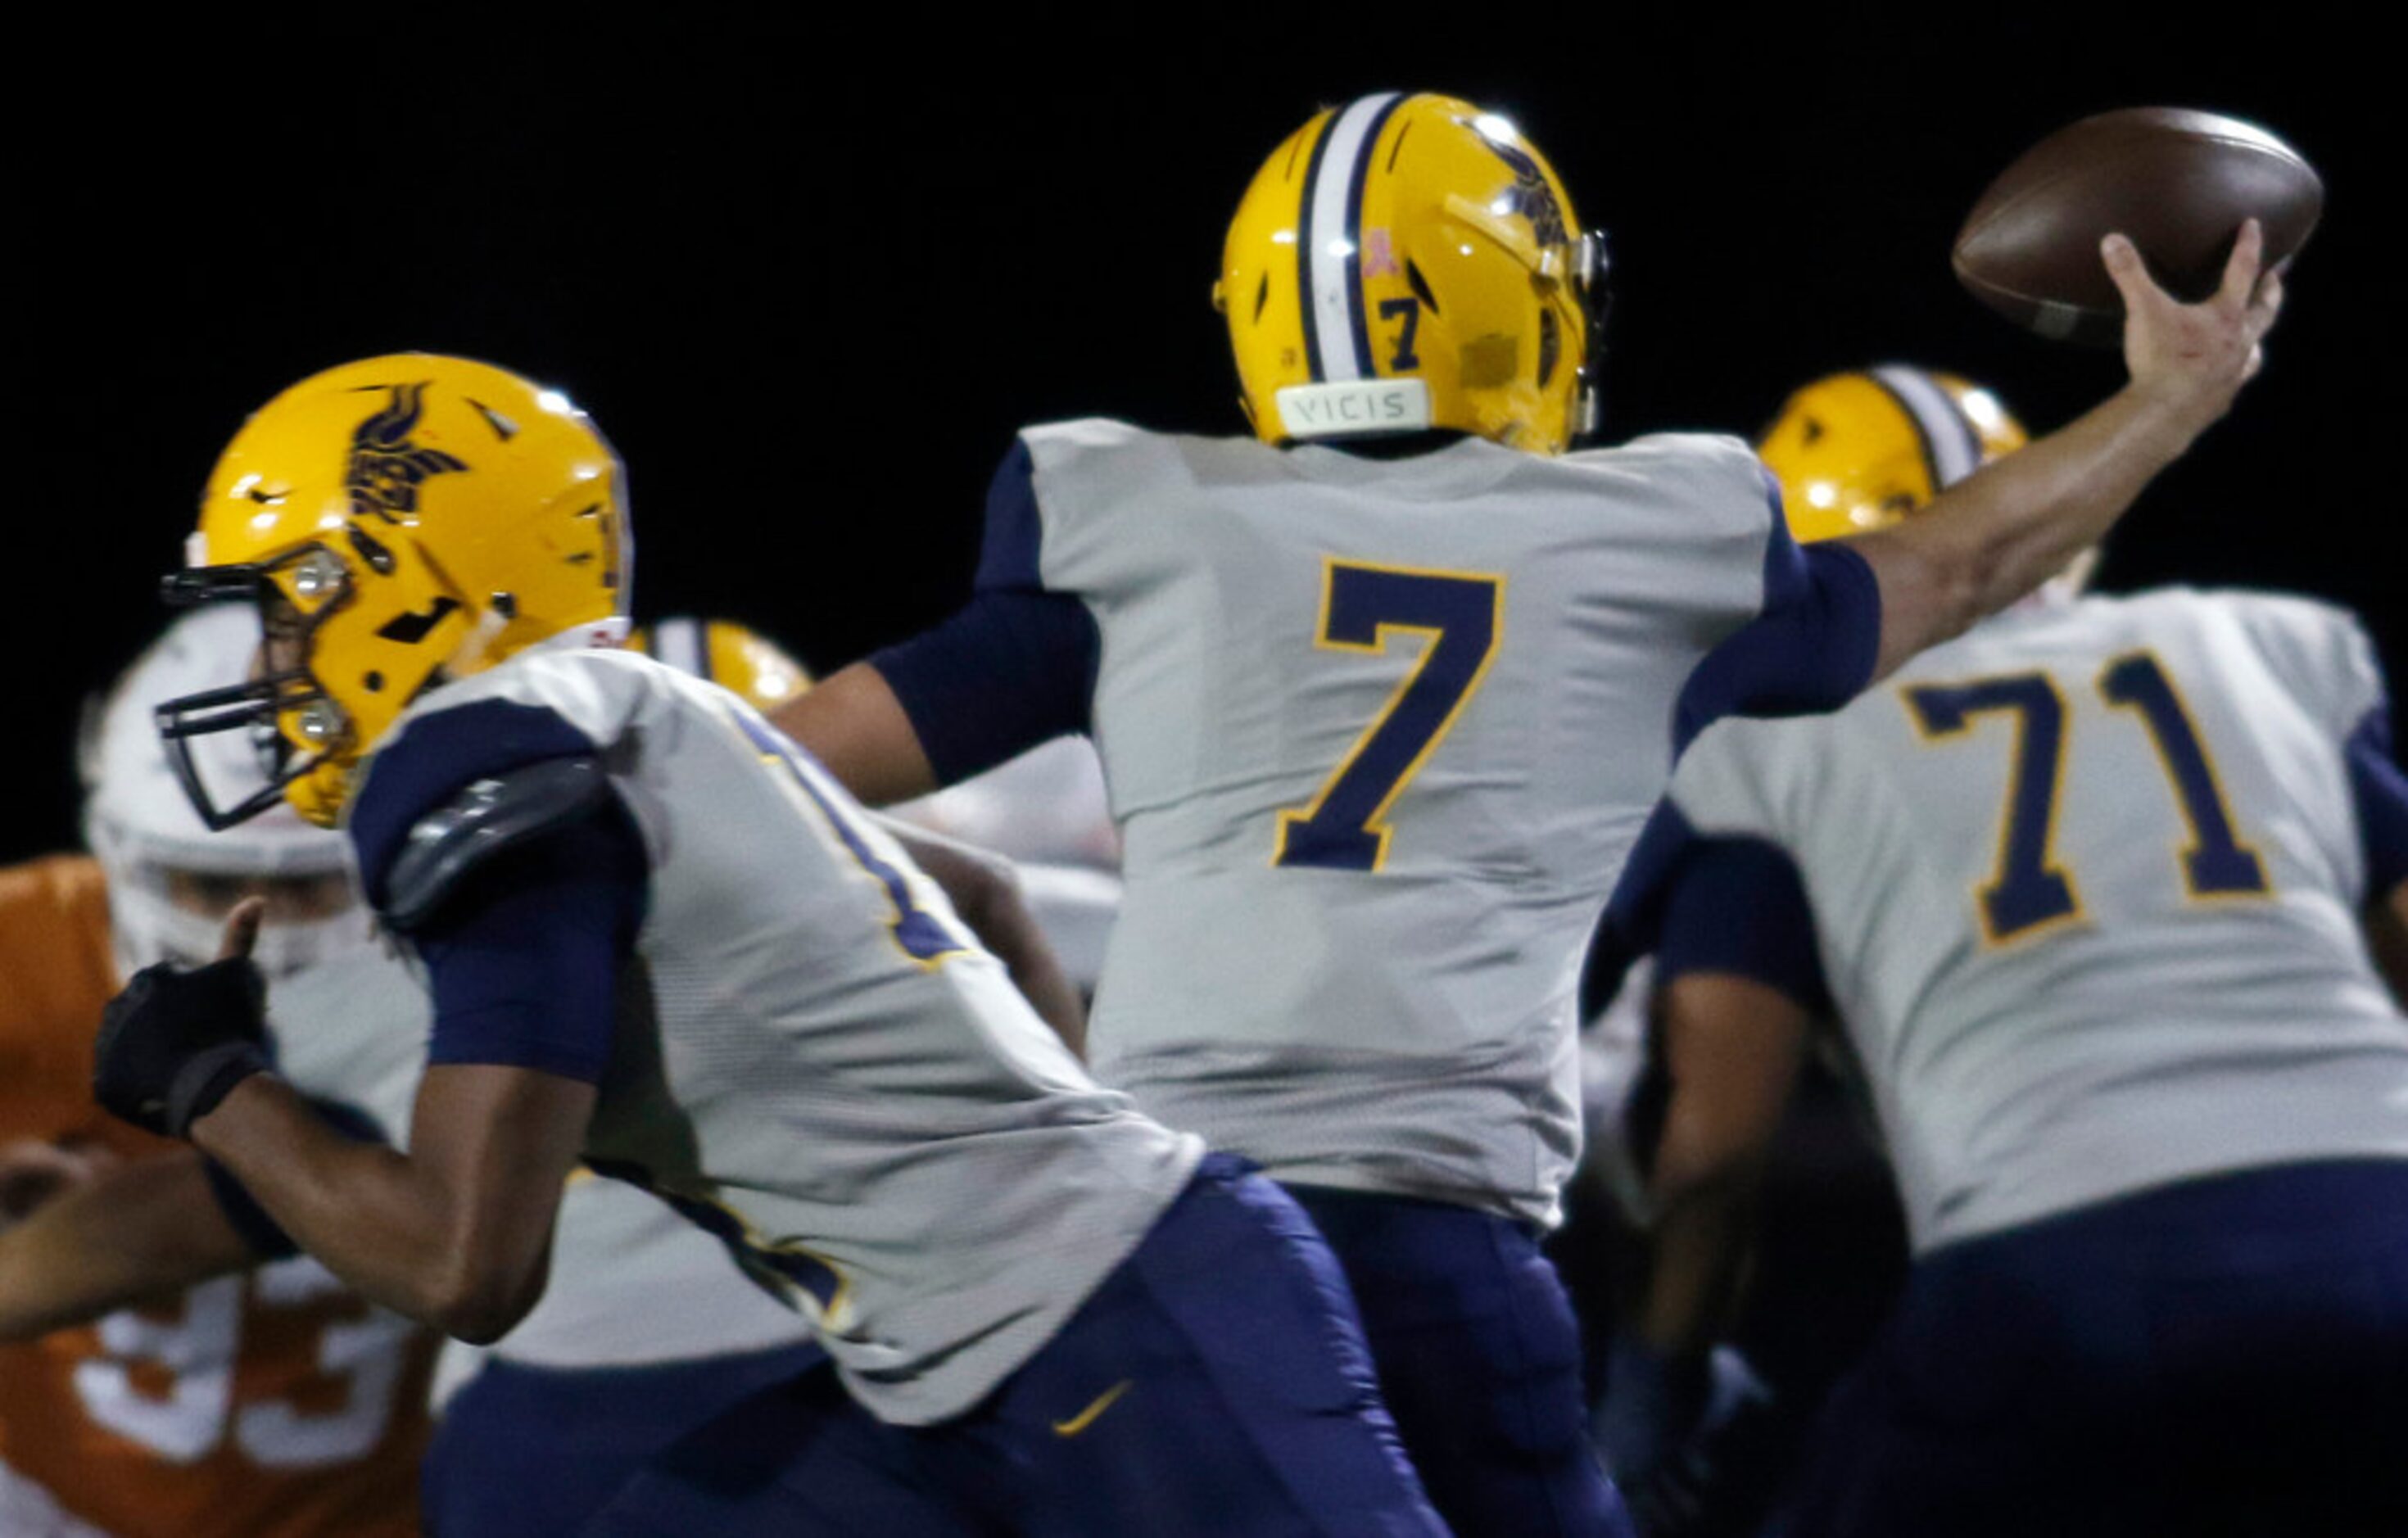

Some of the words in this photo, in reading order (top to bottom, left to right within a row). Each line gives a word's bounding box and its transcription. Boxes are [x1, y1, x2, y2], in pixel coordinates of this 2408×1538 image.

[1293, 392, 1405, 423] VICIS
[1378, 296, 1419, 371] 7
[1270, 554, 1507, 875] 7
[1899, 647, 2273, 952] 71
